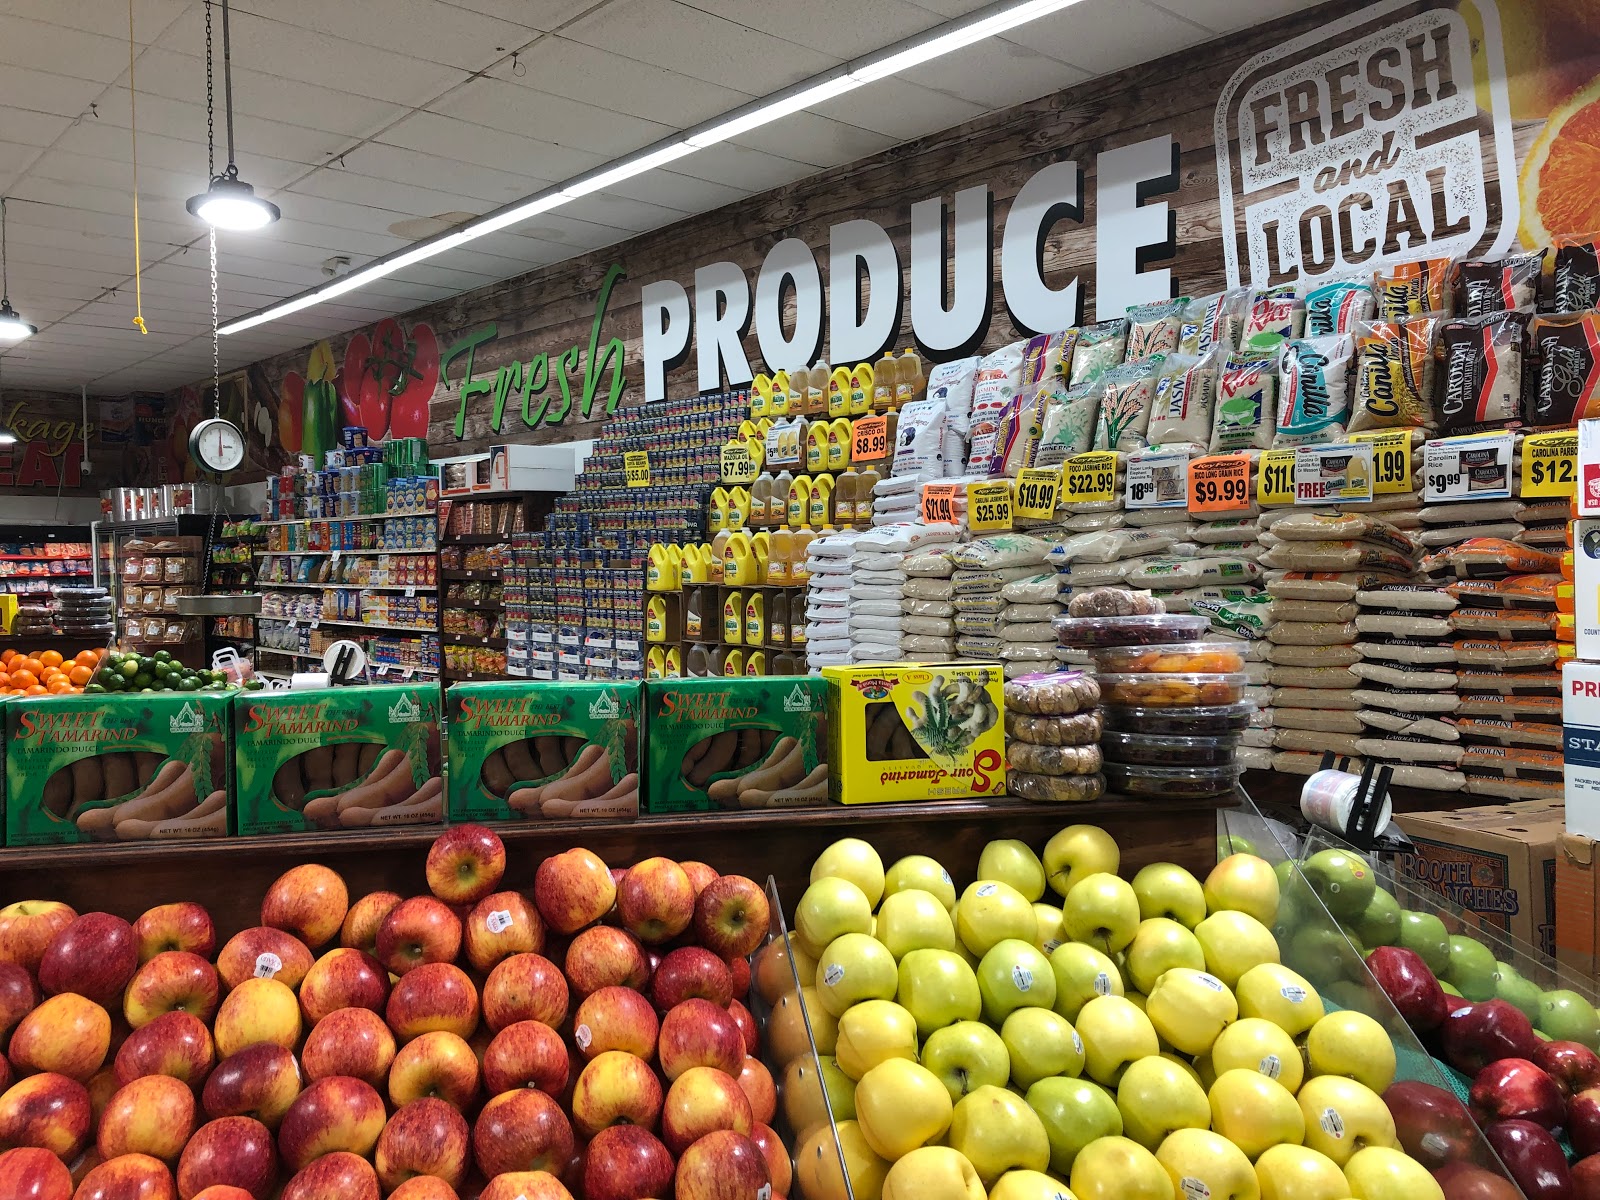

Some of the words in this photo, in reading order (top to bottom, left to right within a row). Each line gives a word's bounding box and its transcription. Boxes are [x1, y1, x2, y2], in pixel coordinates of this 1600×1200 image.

[1250, 23, 1458, 167] FRESH
[1312, 130, 1401, 194] and
[1261, 165, 1471, 288] LOCAL
[441, 263, 626, 440] Fresh
[640, 133, 1175, 403] PRODUCE
[1365, 343, 1399, 416] Canilla
[1442, 341, 1472, 415] CAROLINA
[856, 436, 885, 456] $8.99
[1532, 448, 1559, 458] CAROLINA
[724, 461, 748, 476] $7.99
[1198, 460, 1218, 470] Key
[1219, 460, 1242, 469] Food
[1531, 460, 1578, 486] $12.
[1069, 473, 1113, 496] $22.99
[1196, 479, 1246, 505] $9.99
[1298, 482, 1326, 498] FREE
[1018, 482, 1054, 509] $19.99
[926, 498, 952, 520] $21.99
[976, 503, 1009, 522] $25.99
[1195, 600, 1220, 612] GOYA
[1572, 680, 1600, 698] PR
[456, 696, 533, 725] SWEET
[658, 690, 731, 719] SWEET
[14, 708, 105, 741] SWEET
[244, 703, 328, 734] SWEET
[473, 713, 561, 729] TAMARIND
[675, 707, 758, 723] TAMARIND
[1474, 719, 1512, 728] CAROLINA
[35, 728, 138, 746] TAMARIND
[263, 719, 360, 738] TAMARIND
[247, 738, 296, 747] TAMARINDO
[1467, 746, 1505, 756] CAROLINA
[880, 769, 947, 785] Tamarind
[950, 749, 1002, 792] Sour
[928, 786, 967, 795] FRESH
[1403, 852, 1472, 884] BOOTH
[1456, 852, 1500, 868] ORANGES
